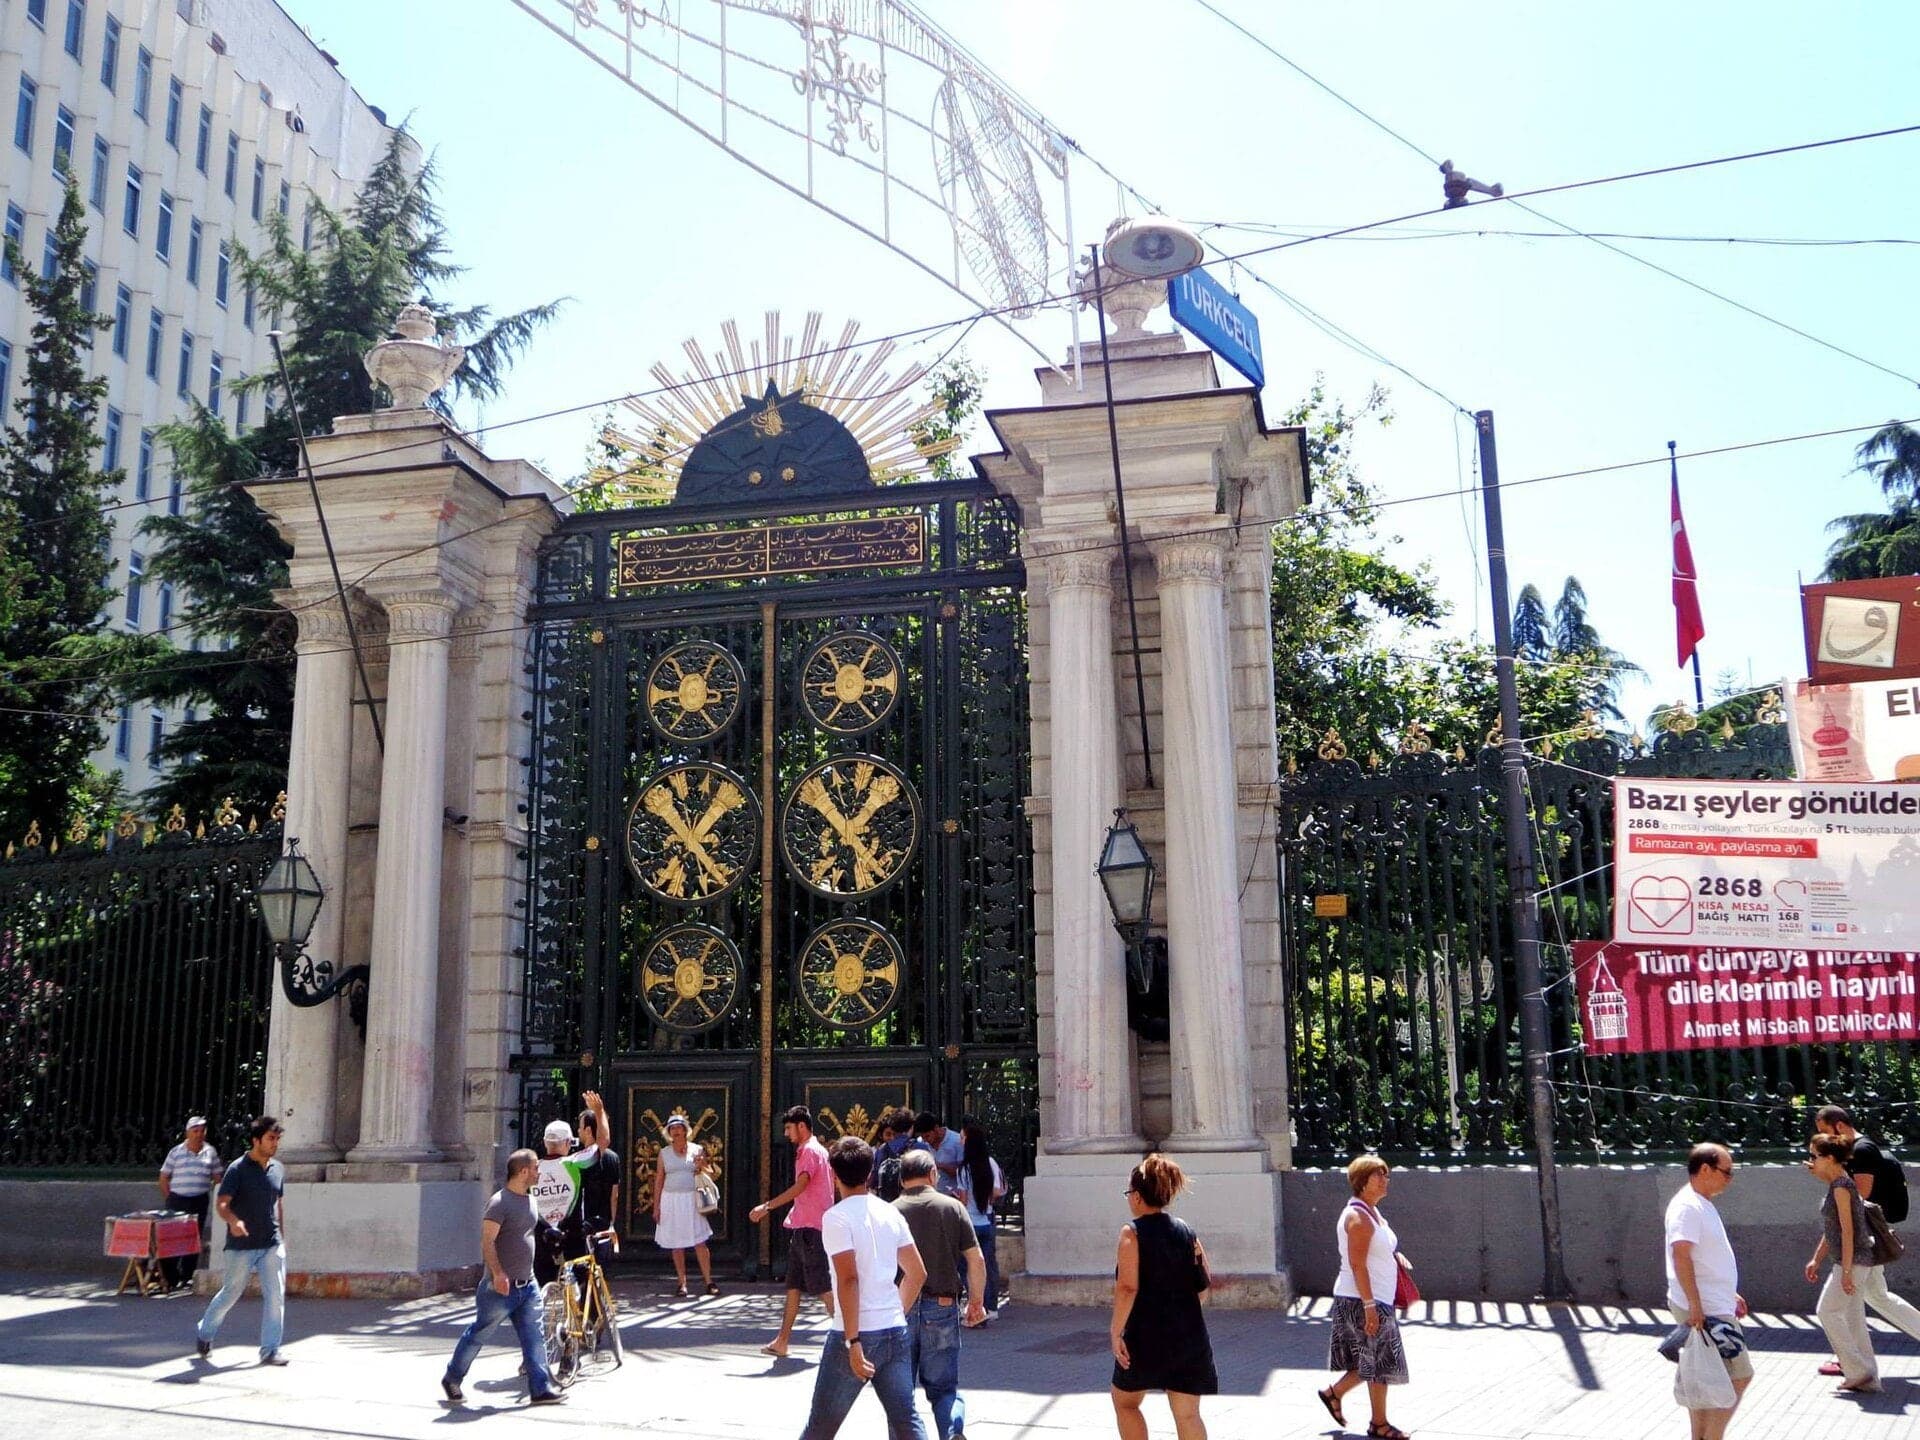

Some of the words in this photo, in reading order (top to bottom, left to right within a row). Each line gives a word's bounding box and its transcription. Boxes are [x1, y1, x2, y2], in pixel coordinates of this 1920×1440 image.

[1628, 787, 1686, 811] Bazı
[1694, 790, 1782, 818] şeyler
[1788, 791, 1920, 819] gönülde
[1826, 823, 1834, 833] 5
[1836, 825, 1850, 833] TL
[1635, 837, 1693, 849] Ramazan
[1721, 841, 1781, 854] paylaşma
[1698, 876, 1762, 897] 2868
[1698, 901, 1724, 911] KISA
[1732, 902, 1769, 912] MESAJ
[1698, 912, 1729, 923] BAĞIŞ
[1738, 914, 1769, 922] HATTI
[1778, 912, 1800, 921] 168
[1635, 950, 1690, 975] Tüm
[1698, 947, 1809, 974] dünyaya
[1668, 974, 1822, 1004] dileklerimle
[1829, 970, 1915, 1001] hayırlı
[1683, 1018, 1741, 1038] Ahmet
[1746, 1015, 1810, 1036] Misbah
[1815, 1010, 1913, 1032] DEMİRCAN
[532, 1183, 570, 1197] DELTA
